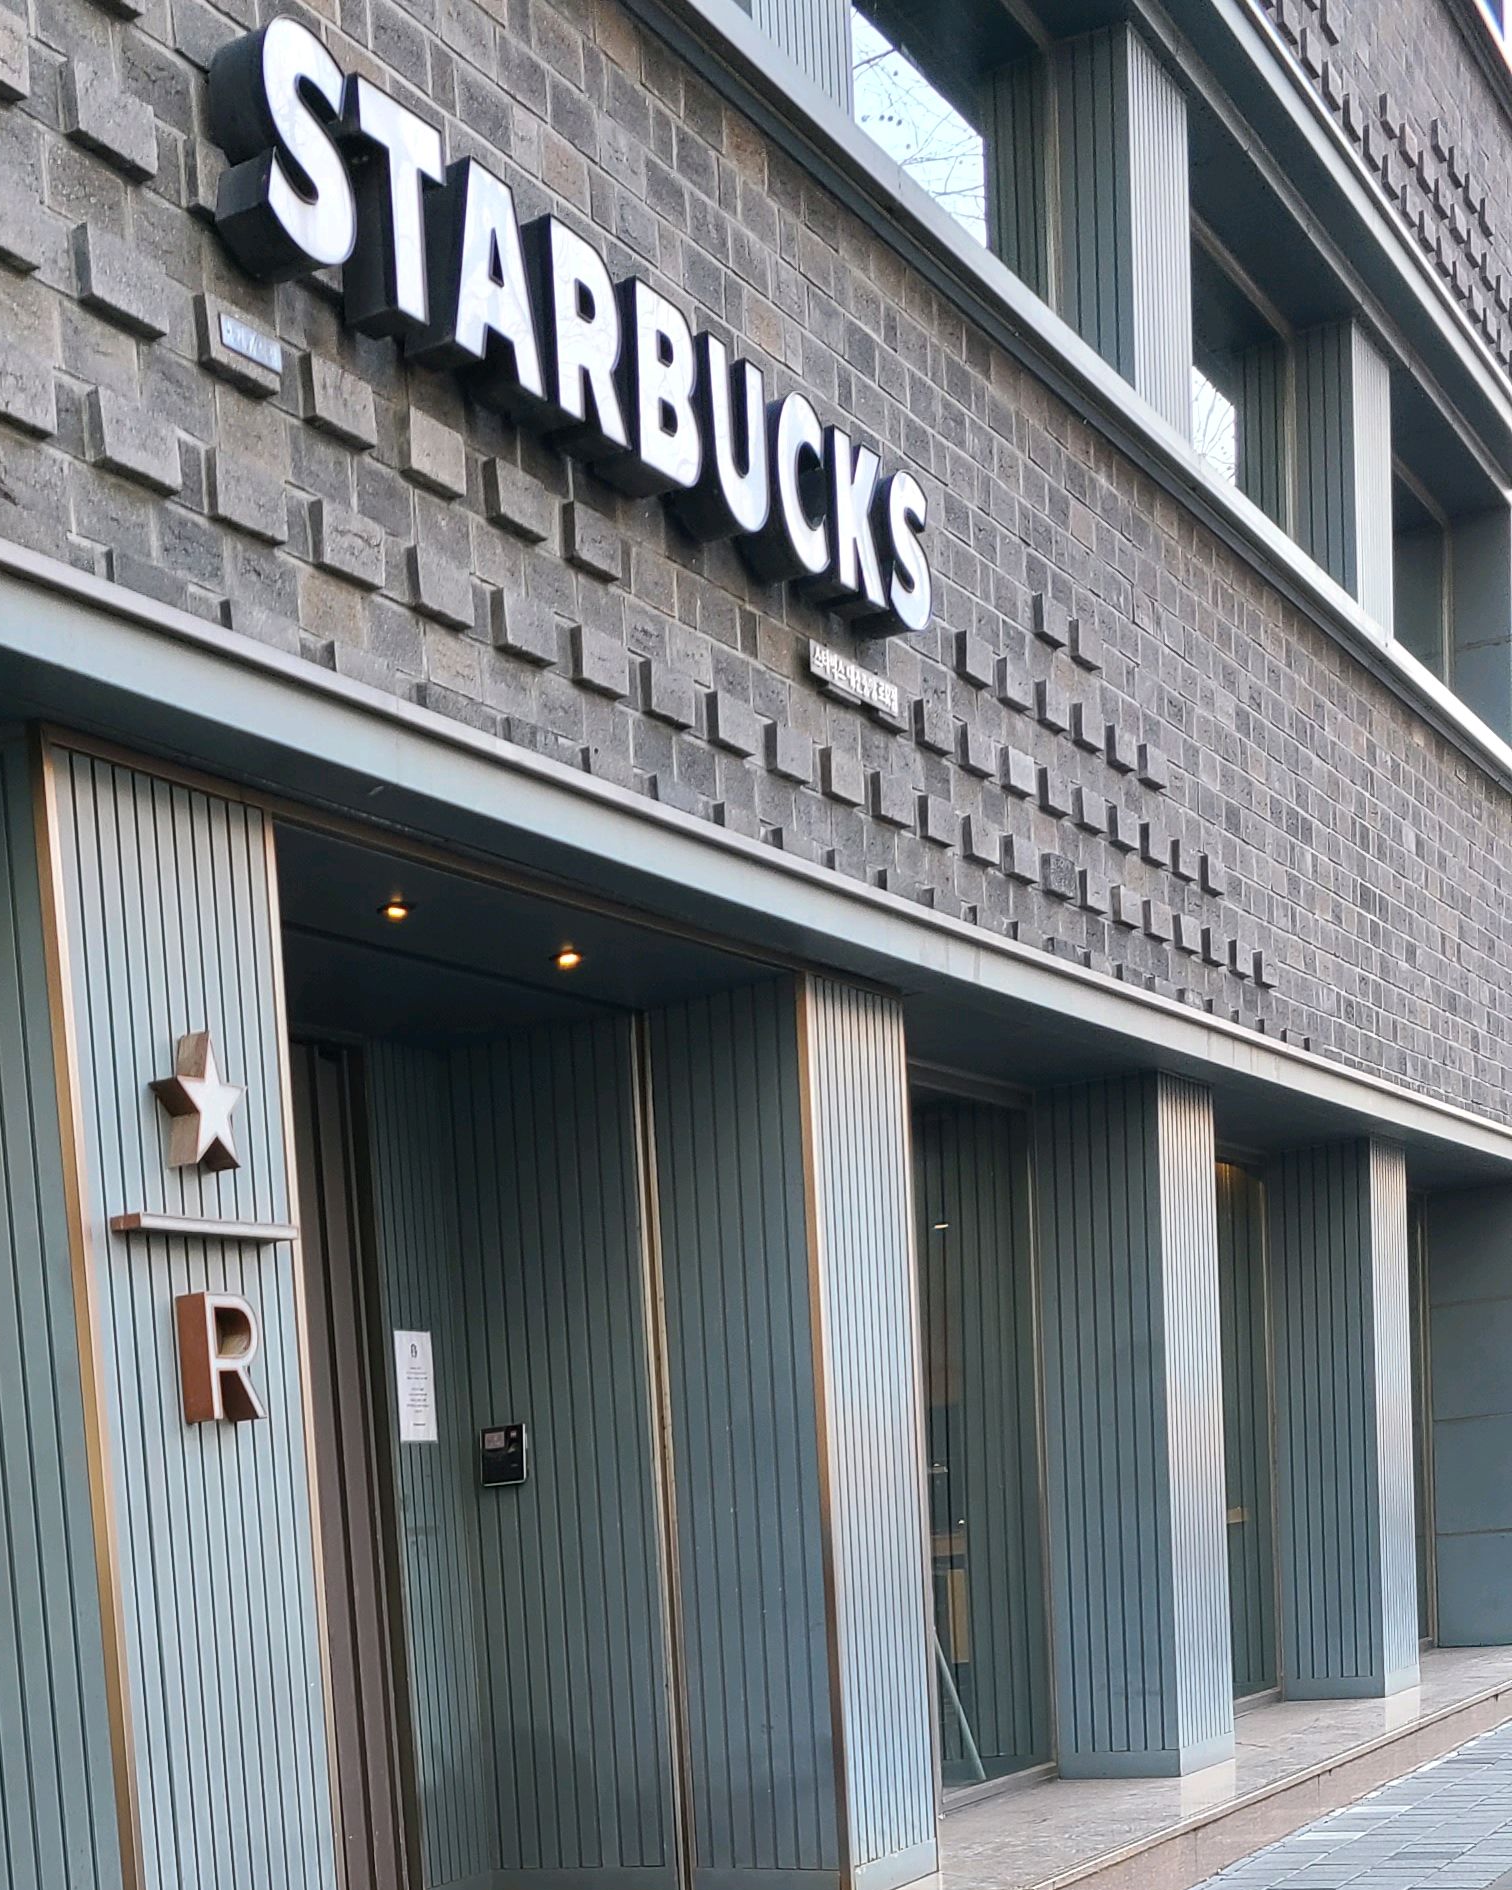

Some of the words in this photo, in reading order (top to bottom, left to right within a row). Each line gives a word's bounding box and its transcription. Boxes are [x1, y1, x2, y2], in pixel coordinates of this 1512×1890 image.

[262, 16, 932, 631] STARBUCKS
[814, 645, 846, 681] 스타벅스
[198, 1290, 268, 1423] R
